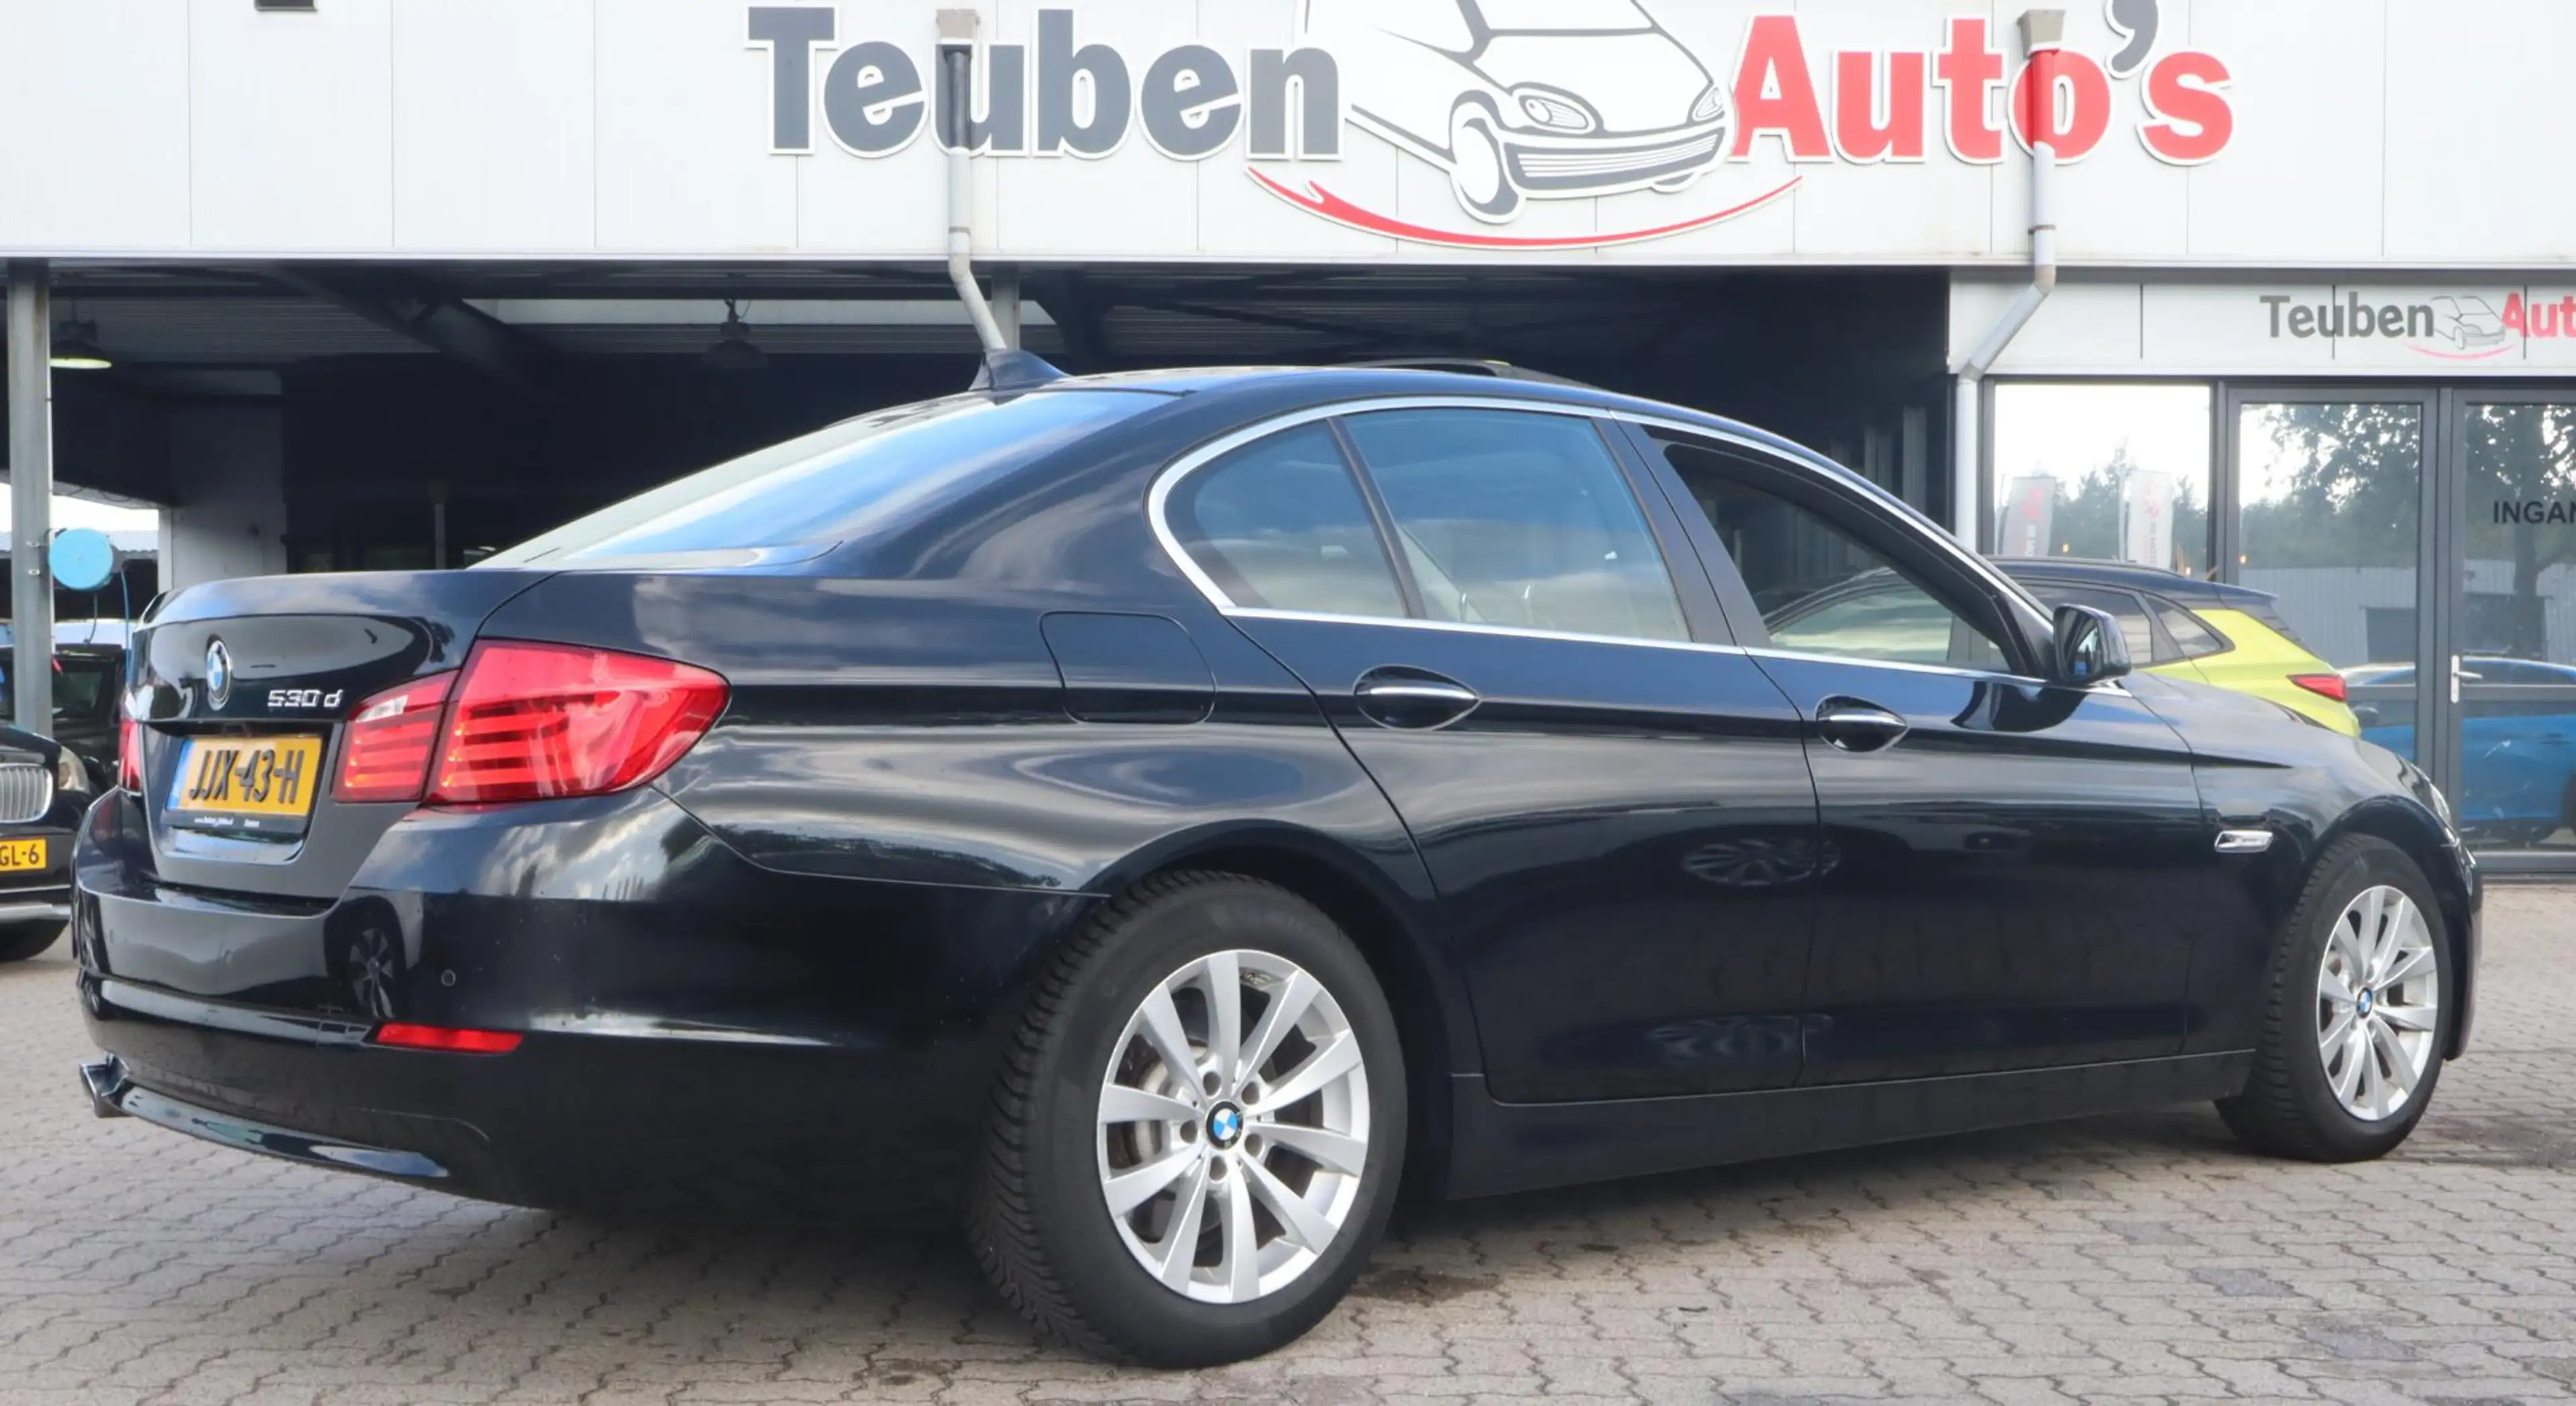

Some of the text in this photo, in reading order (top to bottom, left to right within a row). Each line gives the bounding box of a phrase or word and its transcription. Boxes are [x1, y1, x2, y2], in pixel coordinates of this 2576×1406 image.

[745, 0, 2235, 164] Teuben Auto's
[2259, 291, 2434, 338] Teuben
[189, 749, 305, 804] JJX-43-H
